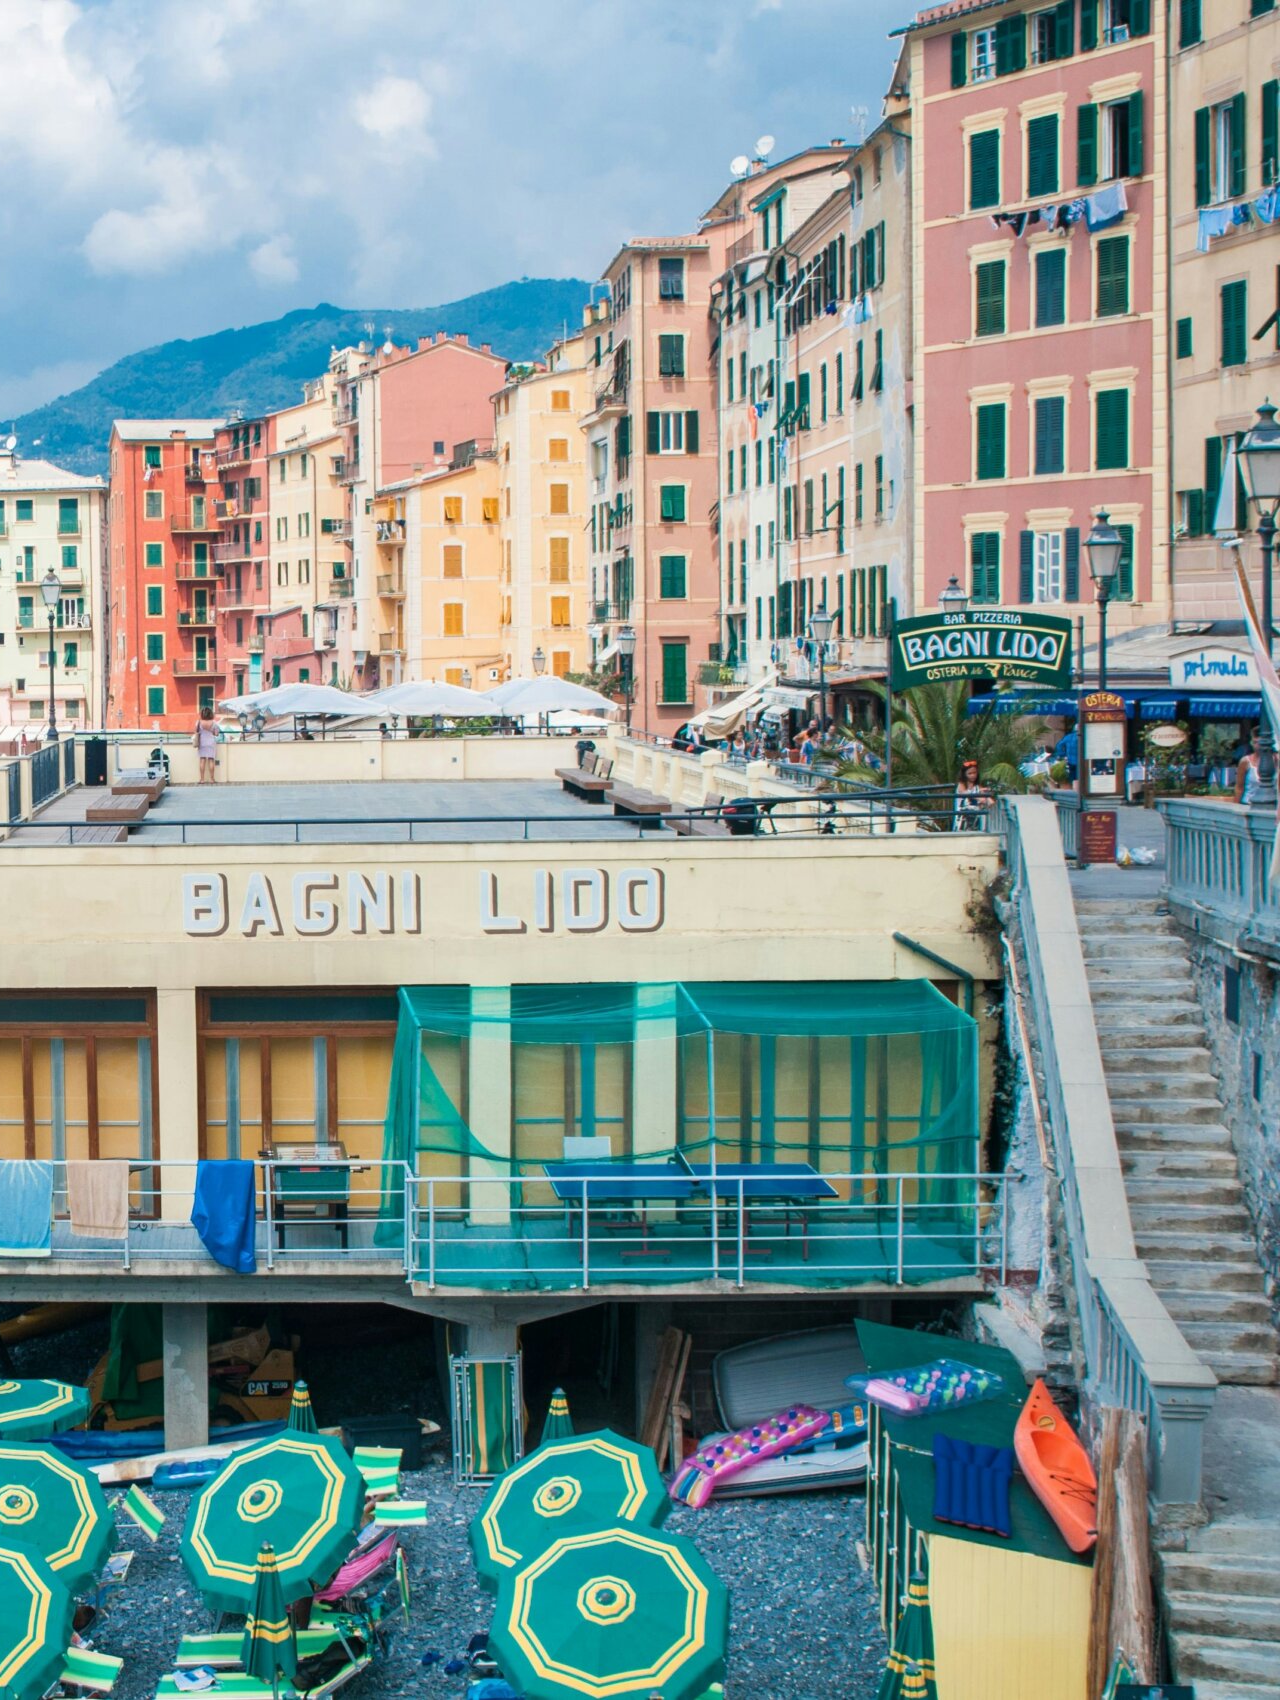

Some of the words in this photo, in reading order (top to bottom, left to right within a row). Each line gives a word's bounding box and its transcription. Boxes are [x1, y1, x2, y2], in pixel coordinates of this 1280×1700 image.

[943, 613, 966, 625] BAR
[972, 612, 1022, 625] PIZZERIA
[905, 630, 990, 664] BAGNI
[996, 631, 1058, 662] LIDO
[926, 665, 968, 680] OSTERIA
[1183, 652, 1248, 682] primula
[1085, 693, 1122, 707] OSTERIA
[182, 869, 421, 937] BAGNI
[479, 867, 665, 934] LIDO
[248, 1382, 269, 1396] CAT
